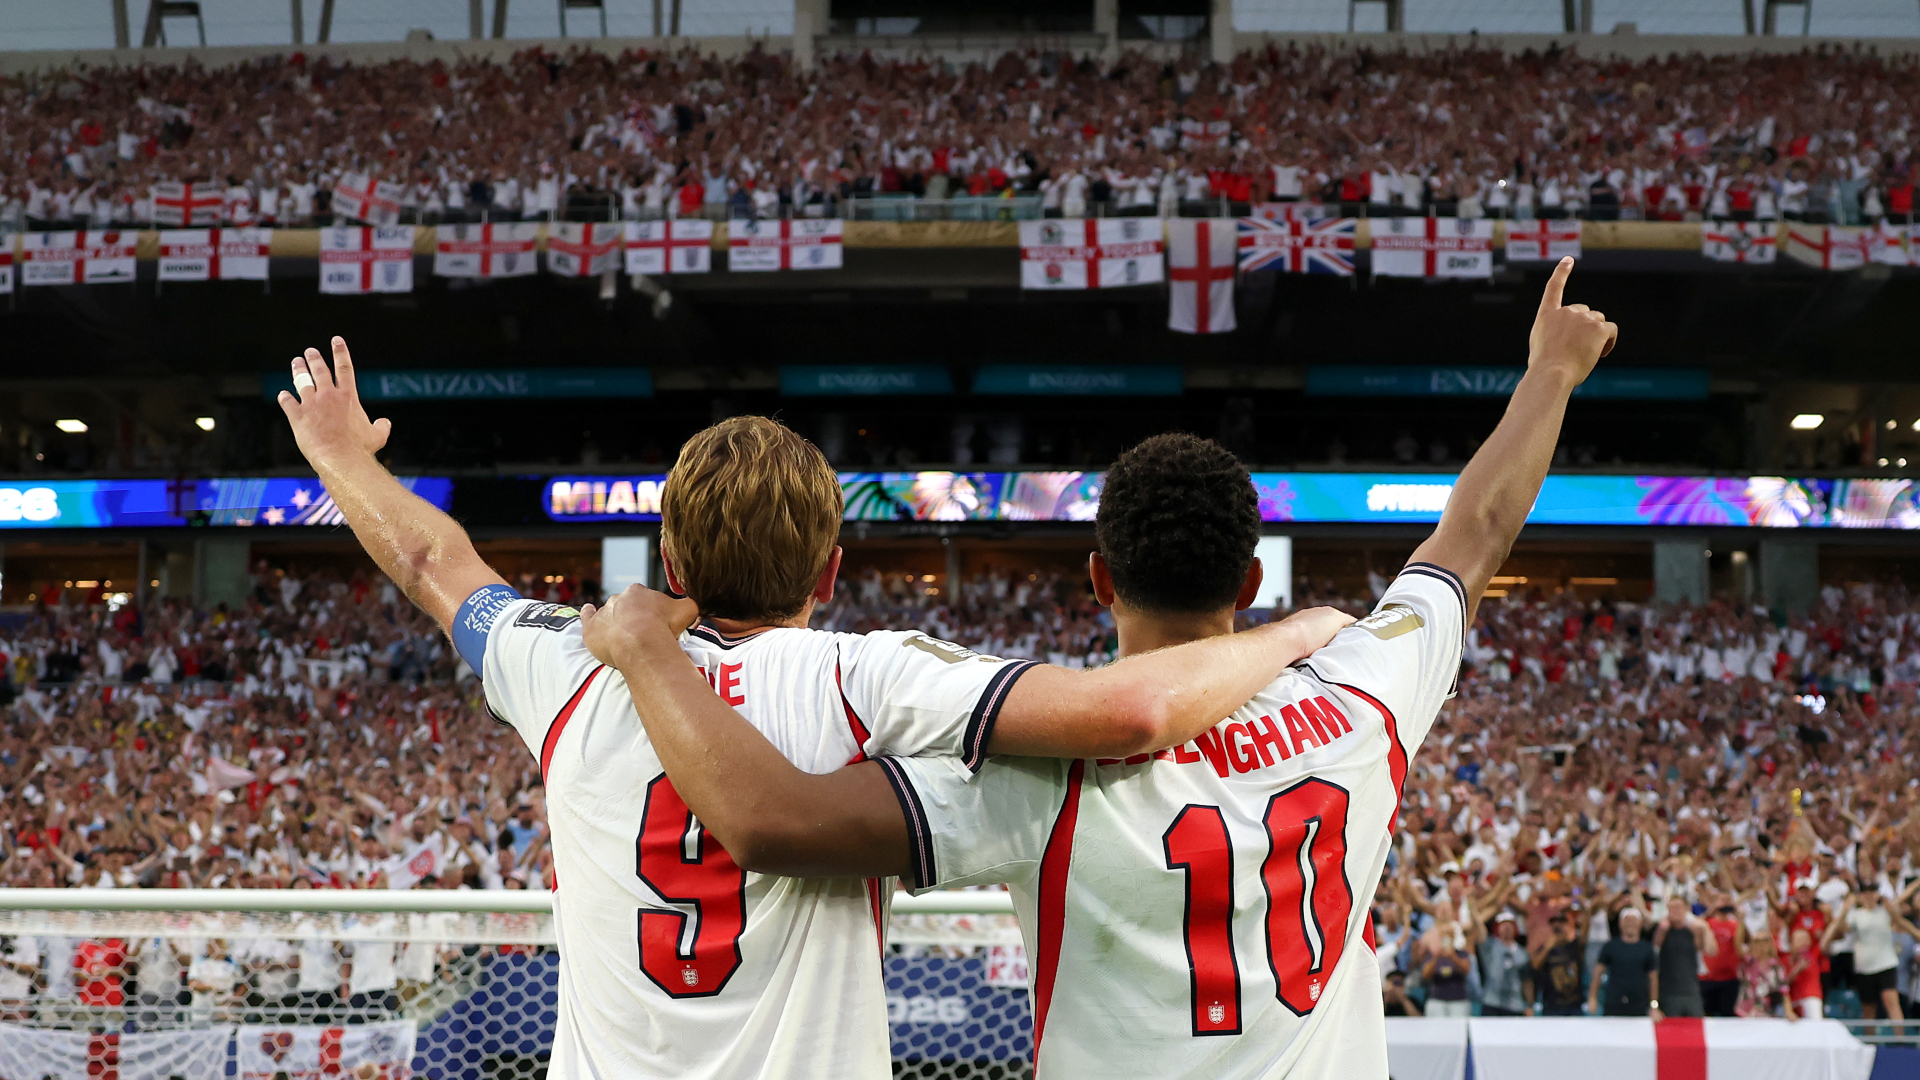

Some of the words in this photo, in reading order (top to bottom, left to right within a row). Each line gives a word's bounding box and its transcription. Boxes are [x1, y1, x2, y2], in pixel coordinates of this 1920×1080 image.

[380, 373, 529, 396] ENDZONE
[818, 372, 916, 388] ENDZONE
[1028, 372, 1127, 388] ENDZONE
[552, 481, 666, 514] MIAM
[635, 770, 748, 999] 9
[1162, 776, 1354, 1037] 10
[887, 996, 967, 1023] 026
